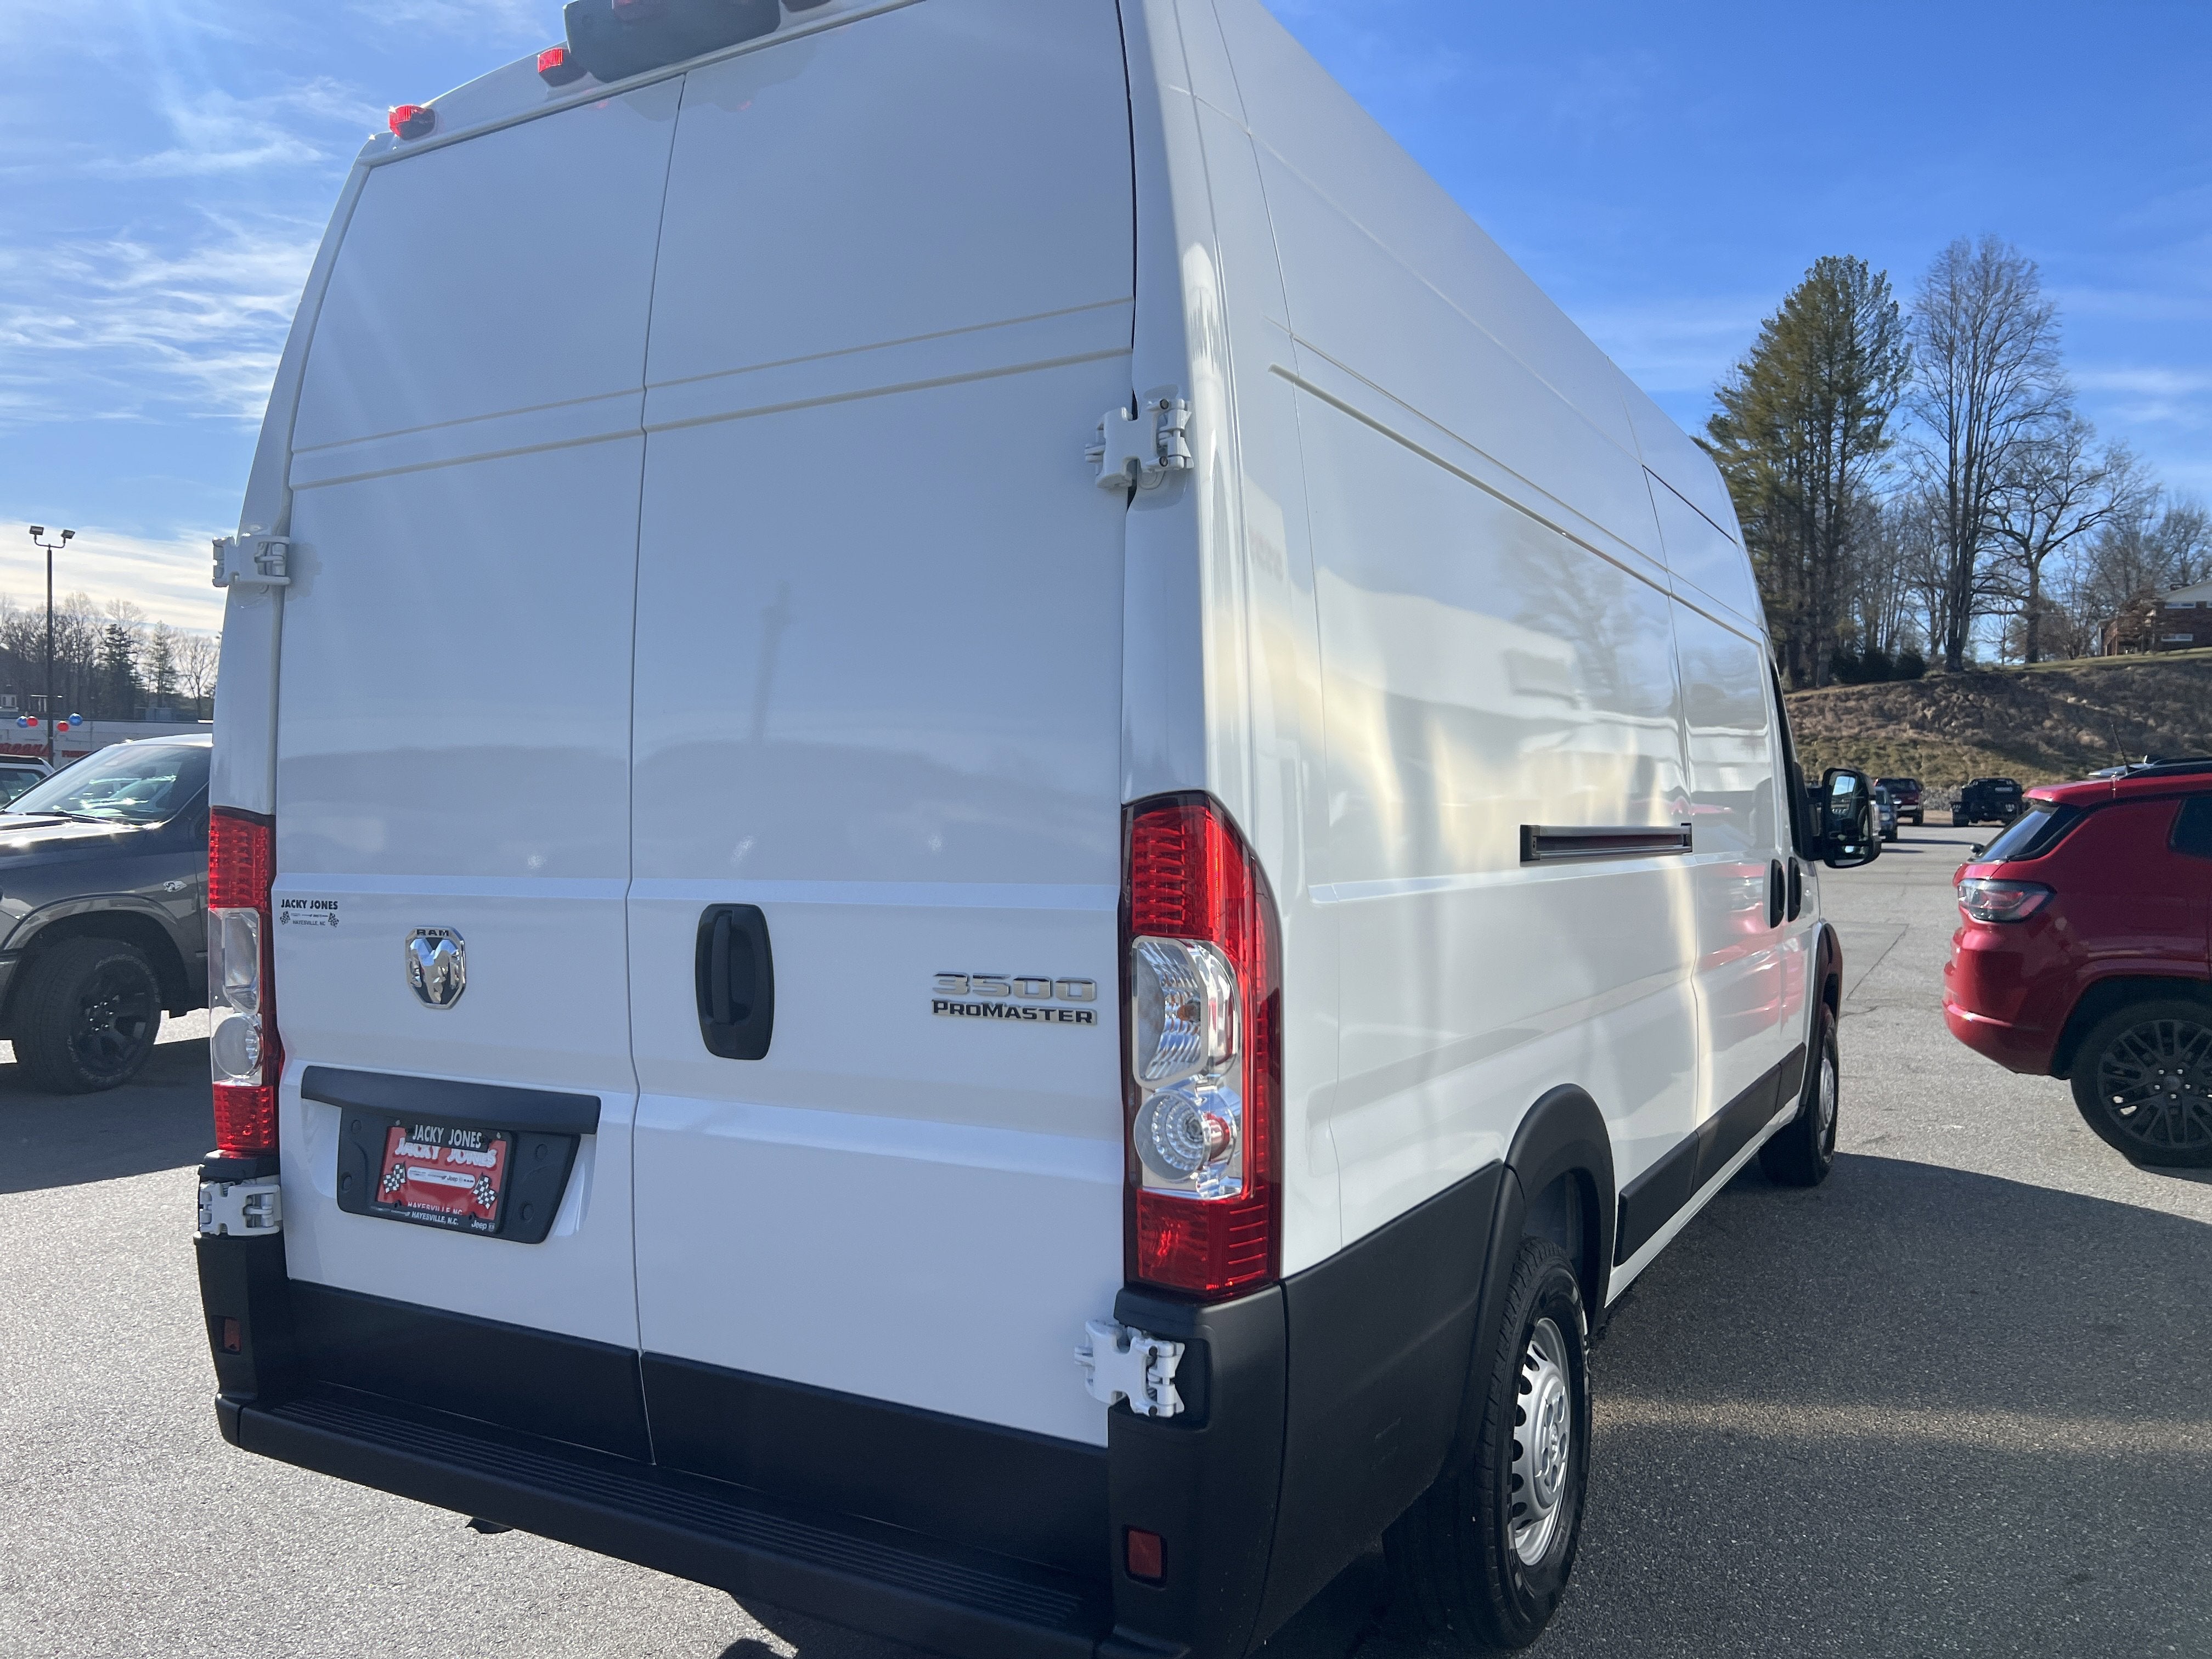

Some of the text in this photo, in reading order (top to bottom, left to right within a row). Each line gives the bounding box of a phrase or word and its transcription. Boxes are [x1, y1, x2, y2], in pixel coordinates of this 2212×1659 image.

[281, 899, 338, 910] JACKY JONES
[932, 971, 1097, 1002] 3500
[412, 1124, 482, 1149] JACKY JONES
[394, 1137, 497, 1168] JACKY JONES
[471, 1220, 487, 1231] Jeep
